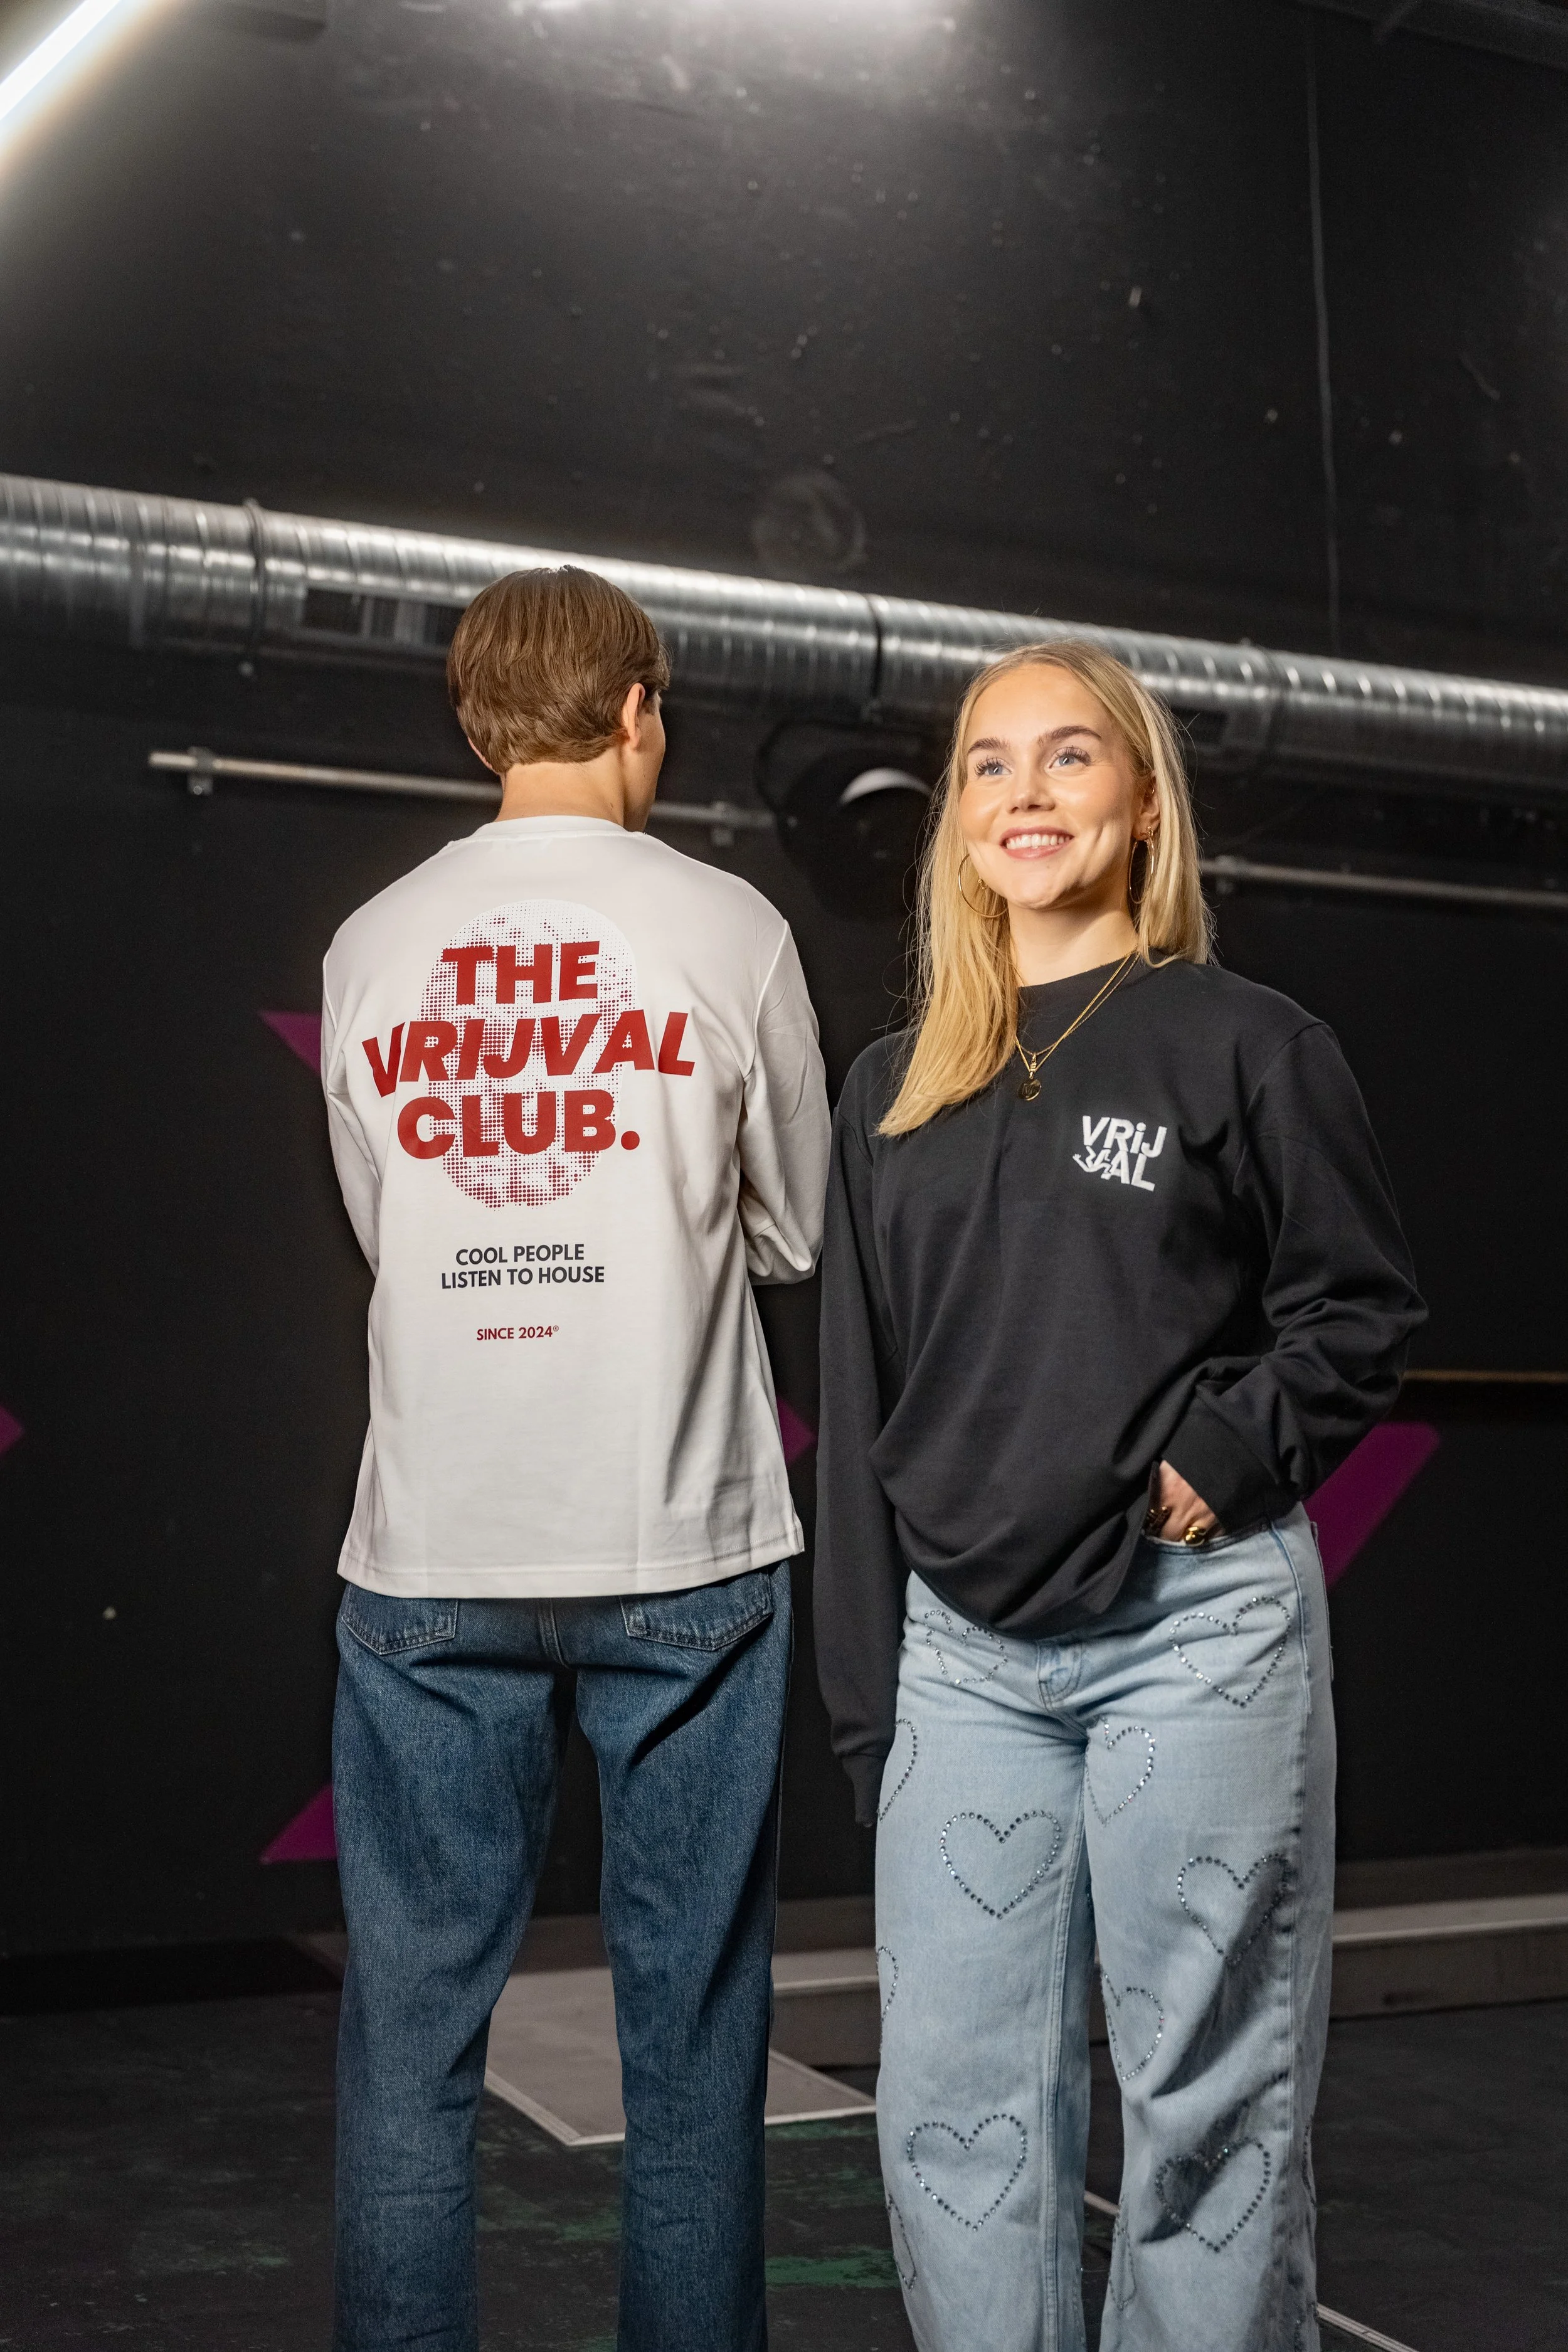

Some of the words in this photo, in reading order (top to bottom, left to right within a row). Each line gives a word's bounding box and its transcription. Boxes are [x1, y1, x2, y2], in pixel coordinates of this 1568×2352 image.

[443, 941, 600, 1005] THE
[362, 1009, 695, 1097] VRIJVAL
[397, 1089, 640, 1159] CLUB.
[456, 1247, 507, 1265] COOL
[514, 1244, 584, 1262] PEOPLE
[442, 1269, 501, 1289] LISTEN
[507, 1268, 533, 1285] TO
[539, 1266, 604, 1283] HOUSE
[477, 1327, 514, 1340] SINCE
